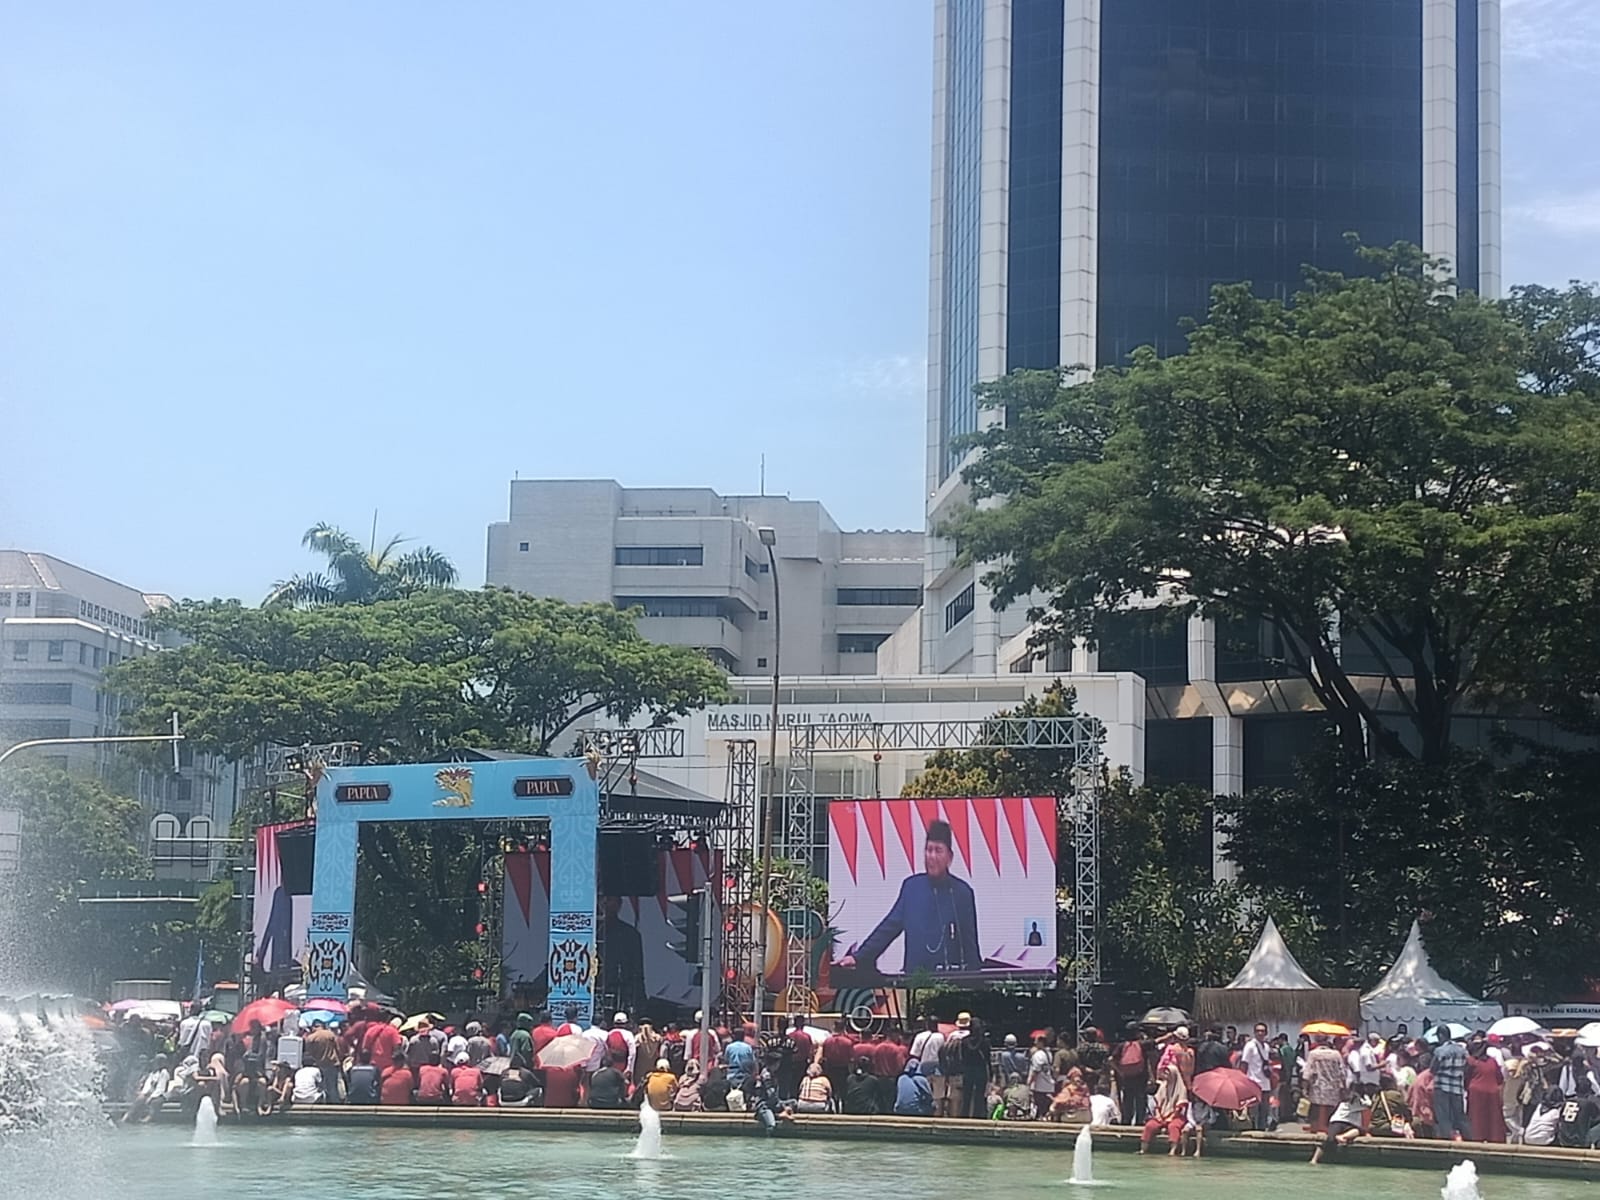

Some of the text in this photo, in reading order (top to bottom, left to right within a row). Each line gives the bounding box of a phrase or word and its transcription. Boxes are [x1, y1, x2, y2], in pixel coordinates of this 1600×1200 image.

[708, 713, 762, 727] MASJID
[347, 787, 378, 800] PAPUA
[527, 781, 559, 794] PAPUA
